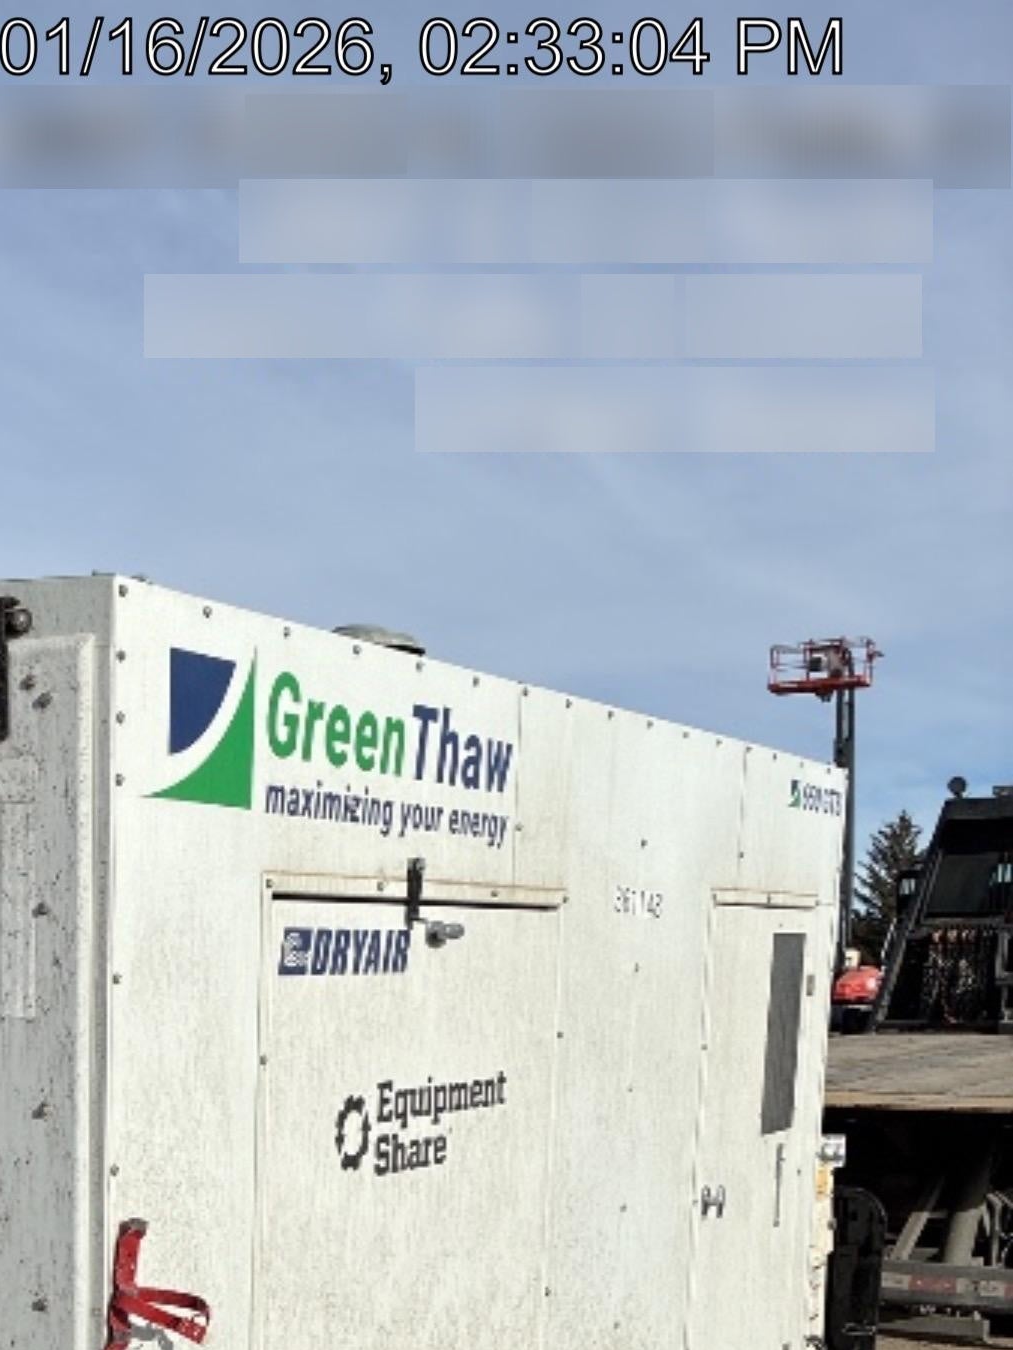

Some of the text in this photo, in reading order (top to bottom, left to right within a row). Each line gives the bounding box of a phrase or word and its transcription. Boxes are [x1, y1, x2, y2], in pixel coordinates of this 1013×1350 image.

[265, 780, 509, 849] maximizing your energy
[310, 928, 410, 976] DRYAIR
[376, 1070, 507, 1129] Equipment
[374, 1133, 447, 1176] Share
